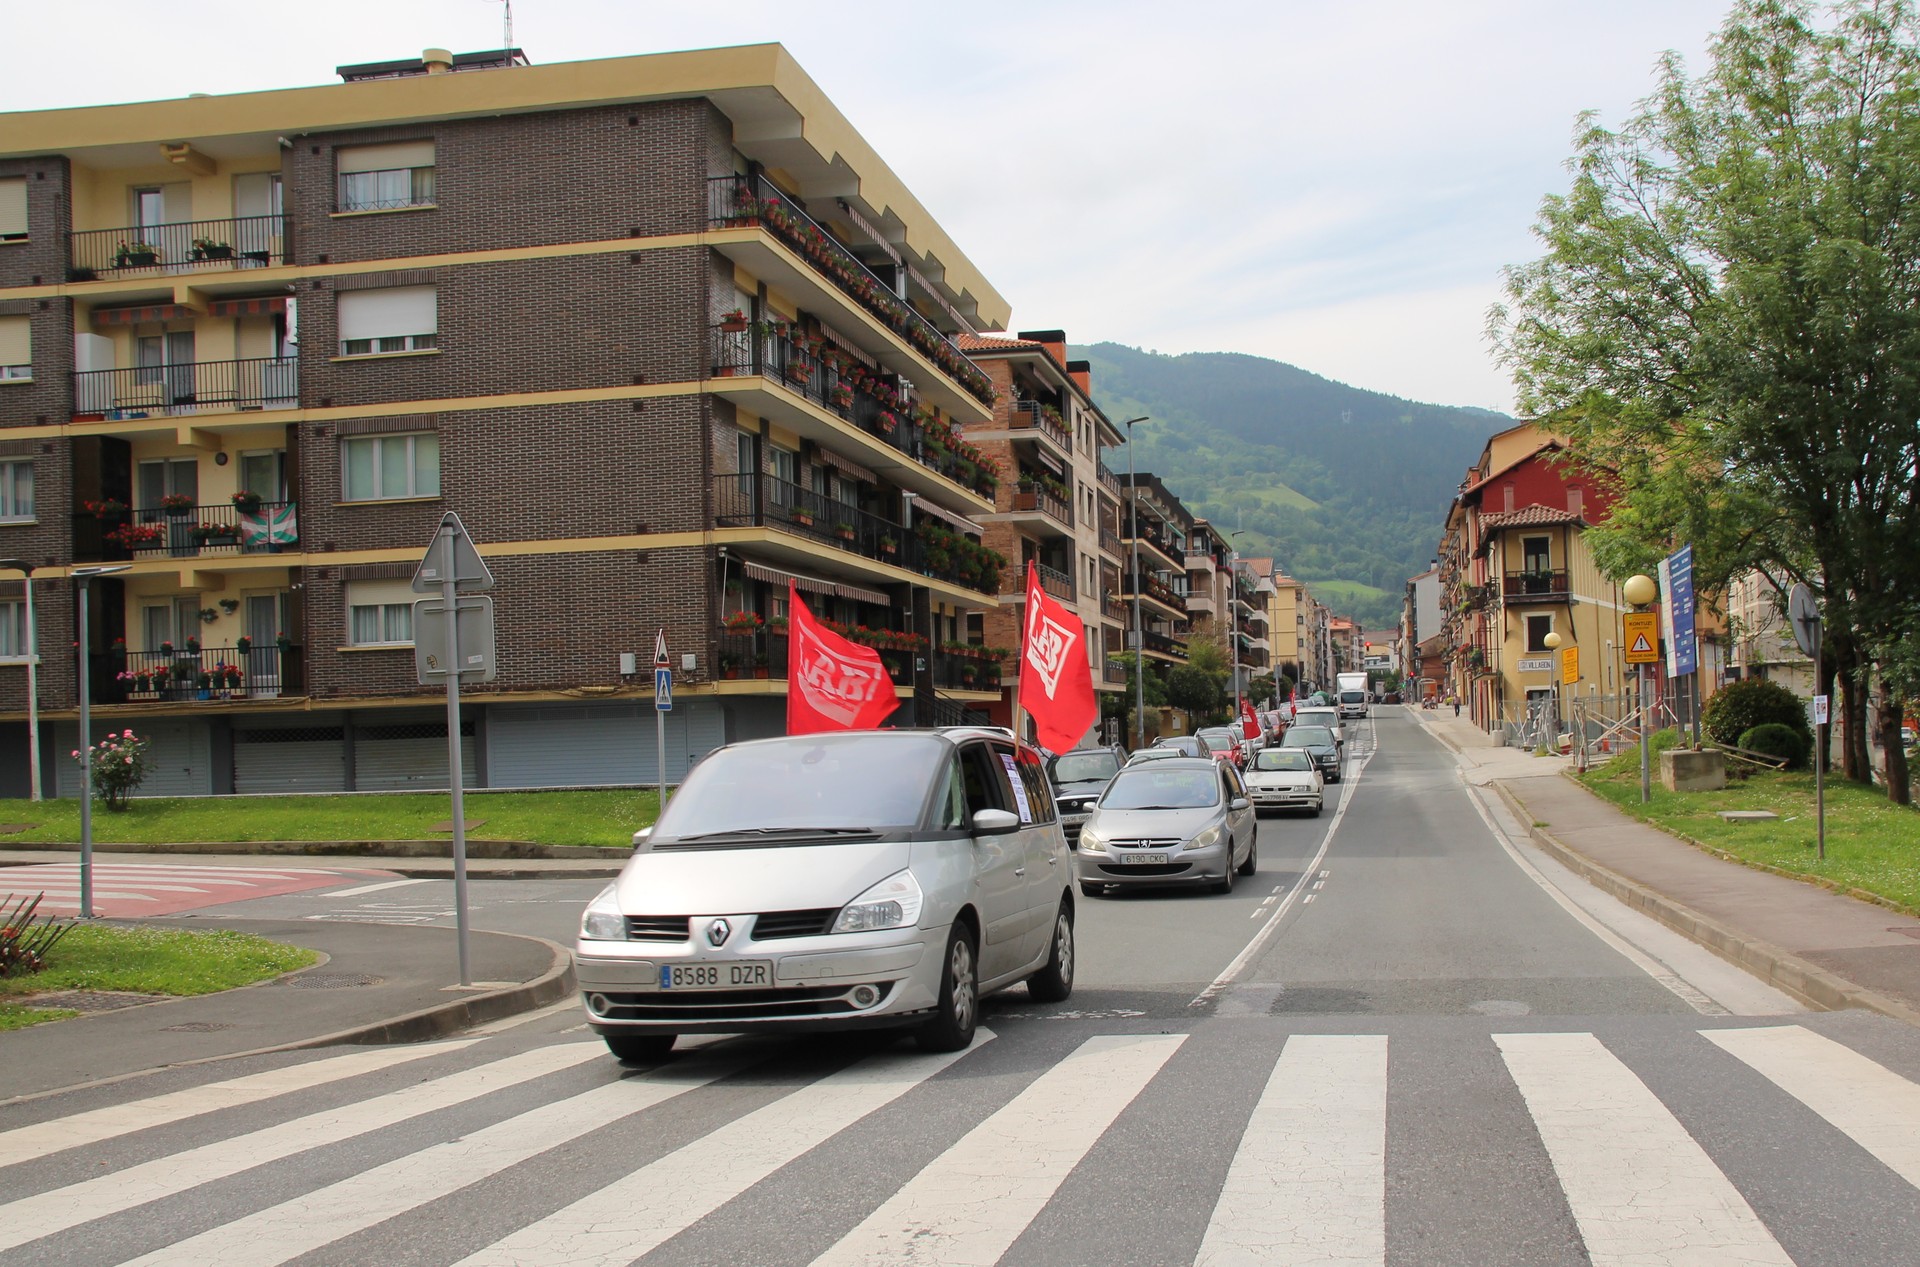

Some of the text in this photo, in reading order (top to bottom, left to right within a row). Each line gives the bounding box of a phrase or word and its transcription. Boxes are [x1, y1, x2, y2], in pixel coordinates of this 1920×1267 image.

[1028, 598, 1063, 672] LAB
[1528, 660, 1553, 669] VILLABON
[1126, 854, 1164, 863] 6190 CKC
[673, 965, 766, 986] 8588 DZR
